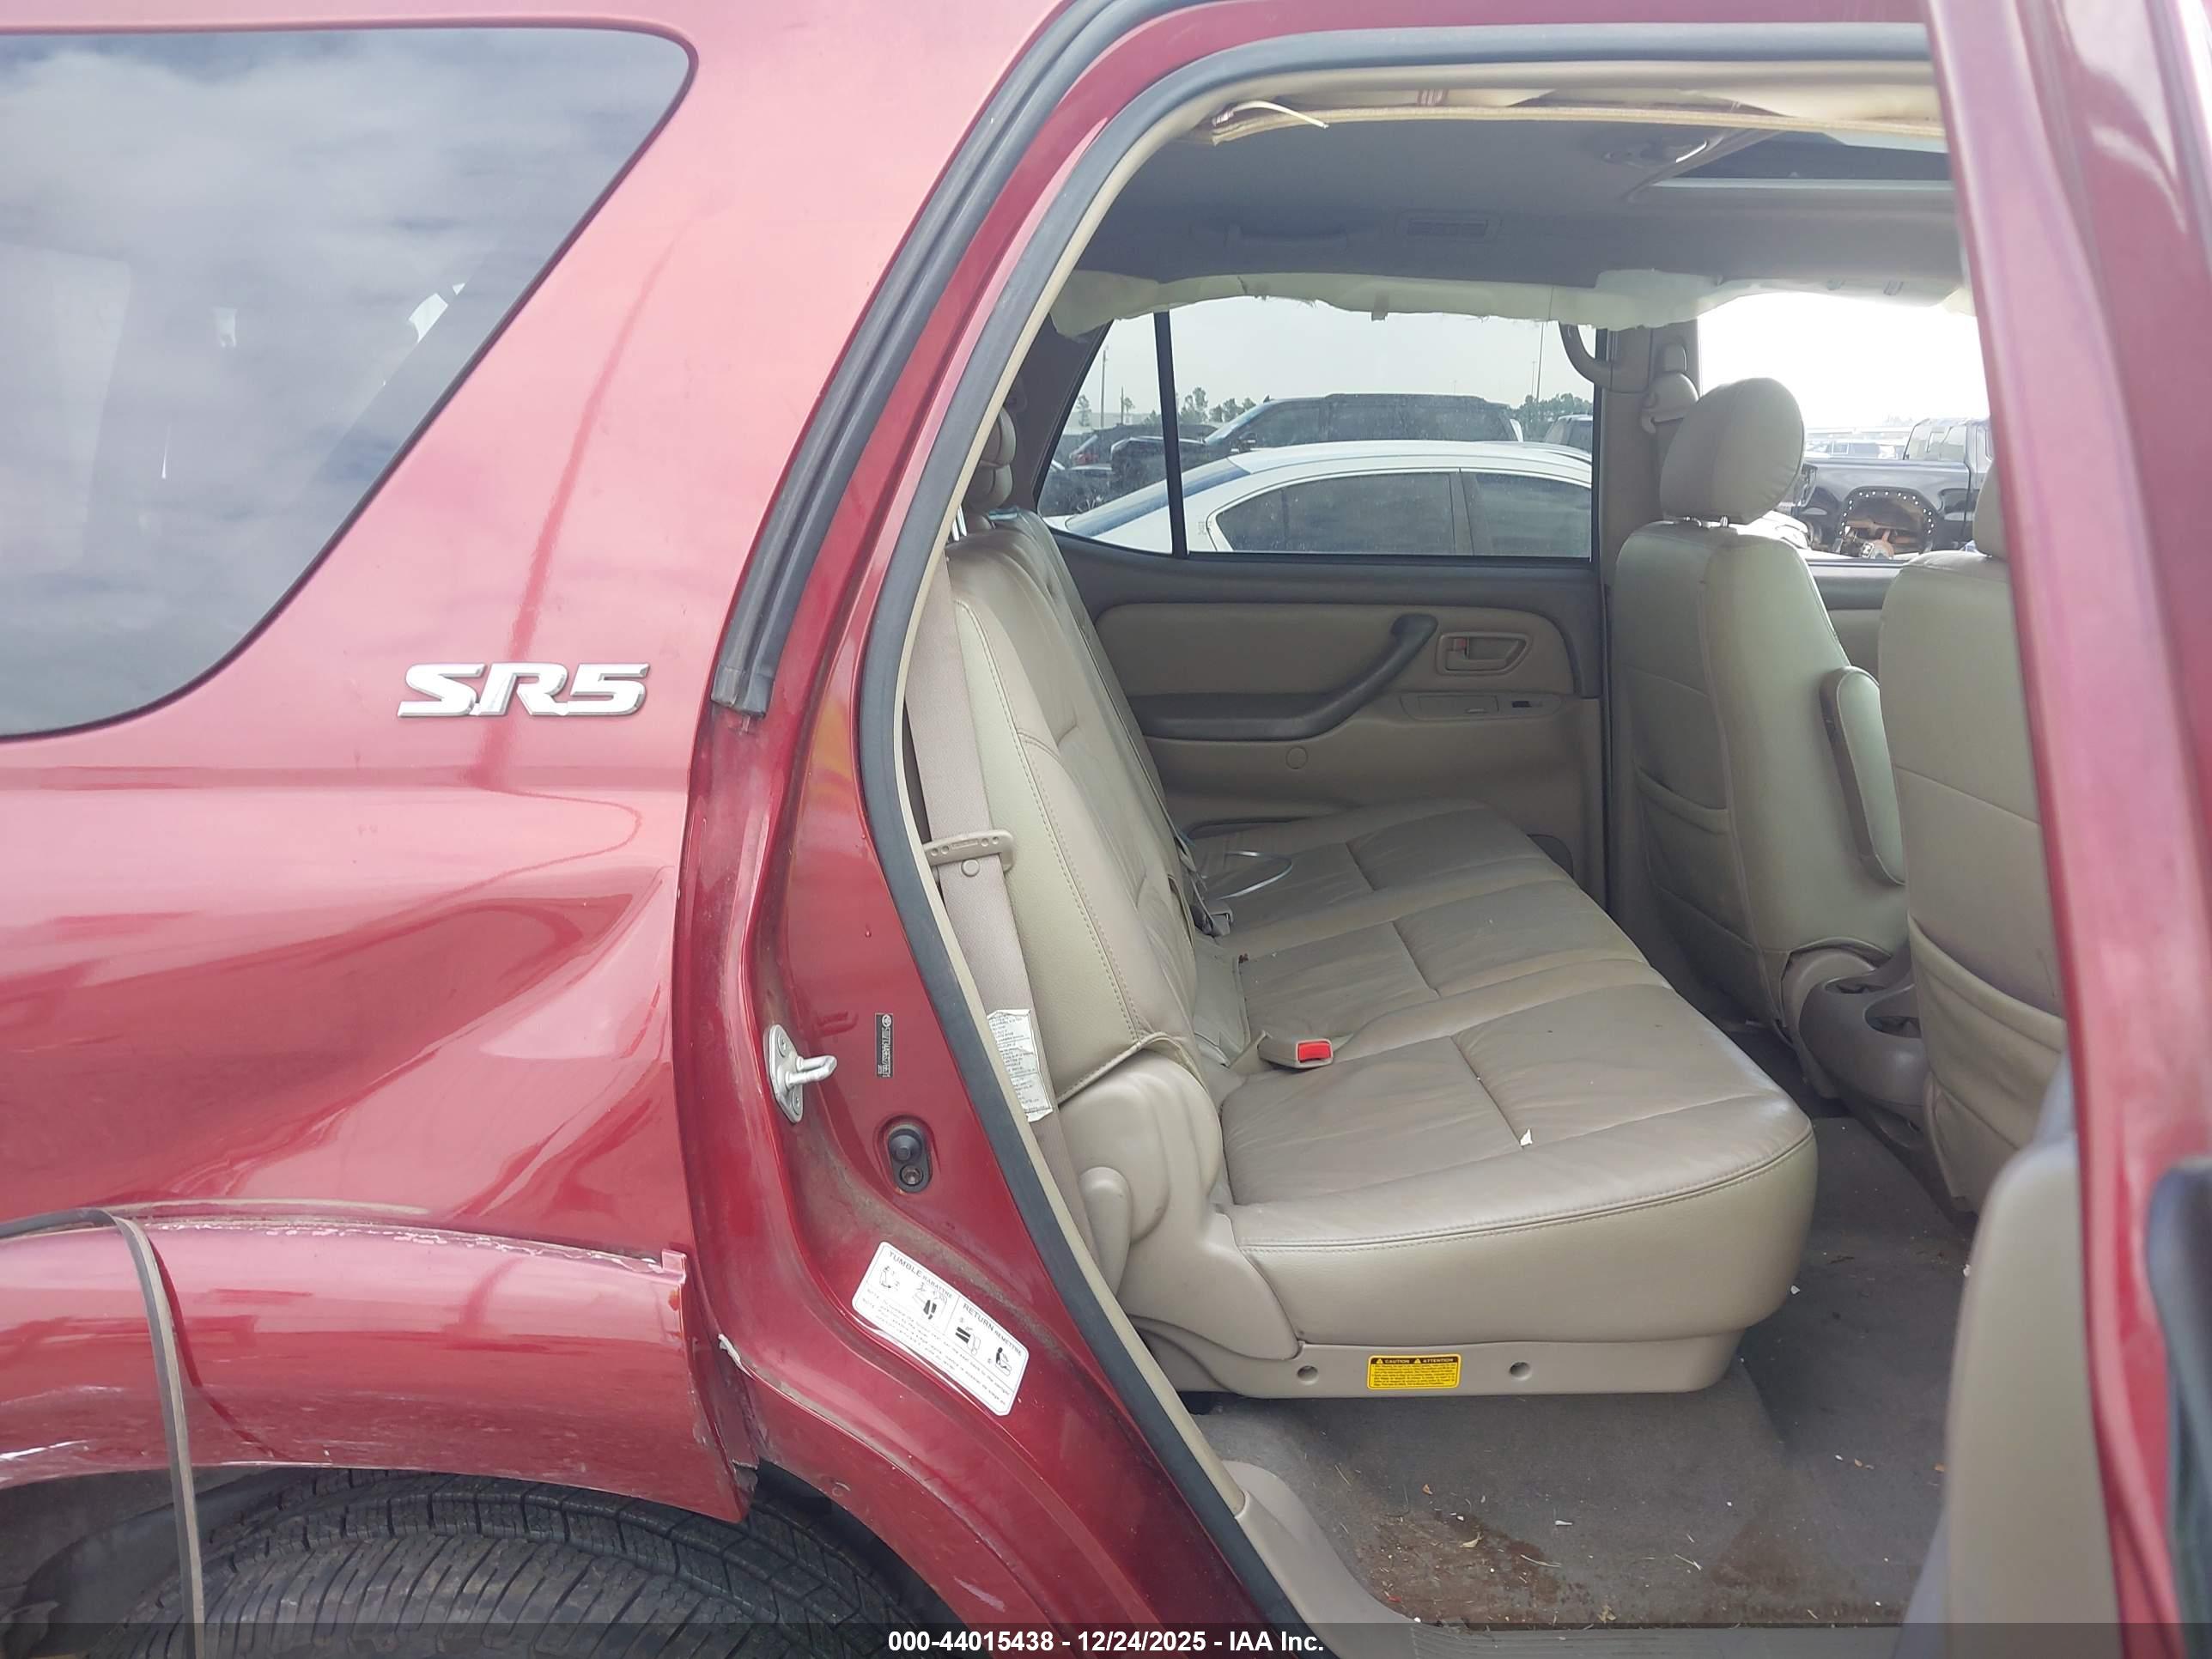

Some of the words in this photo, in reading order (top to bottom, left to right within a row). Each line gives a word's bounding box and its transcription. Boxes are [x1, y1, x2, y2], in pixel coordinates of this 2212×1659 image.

[397, 663, 650, 717] SR5
[889, 1250, 922, 1278] TUMBLE
[963, 1303, 994, 1332] RETURN
